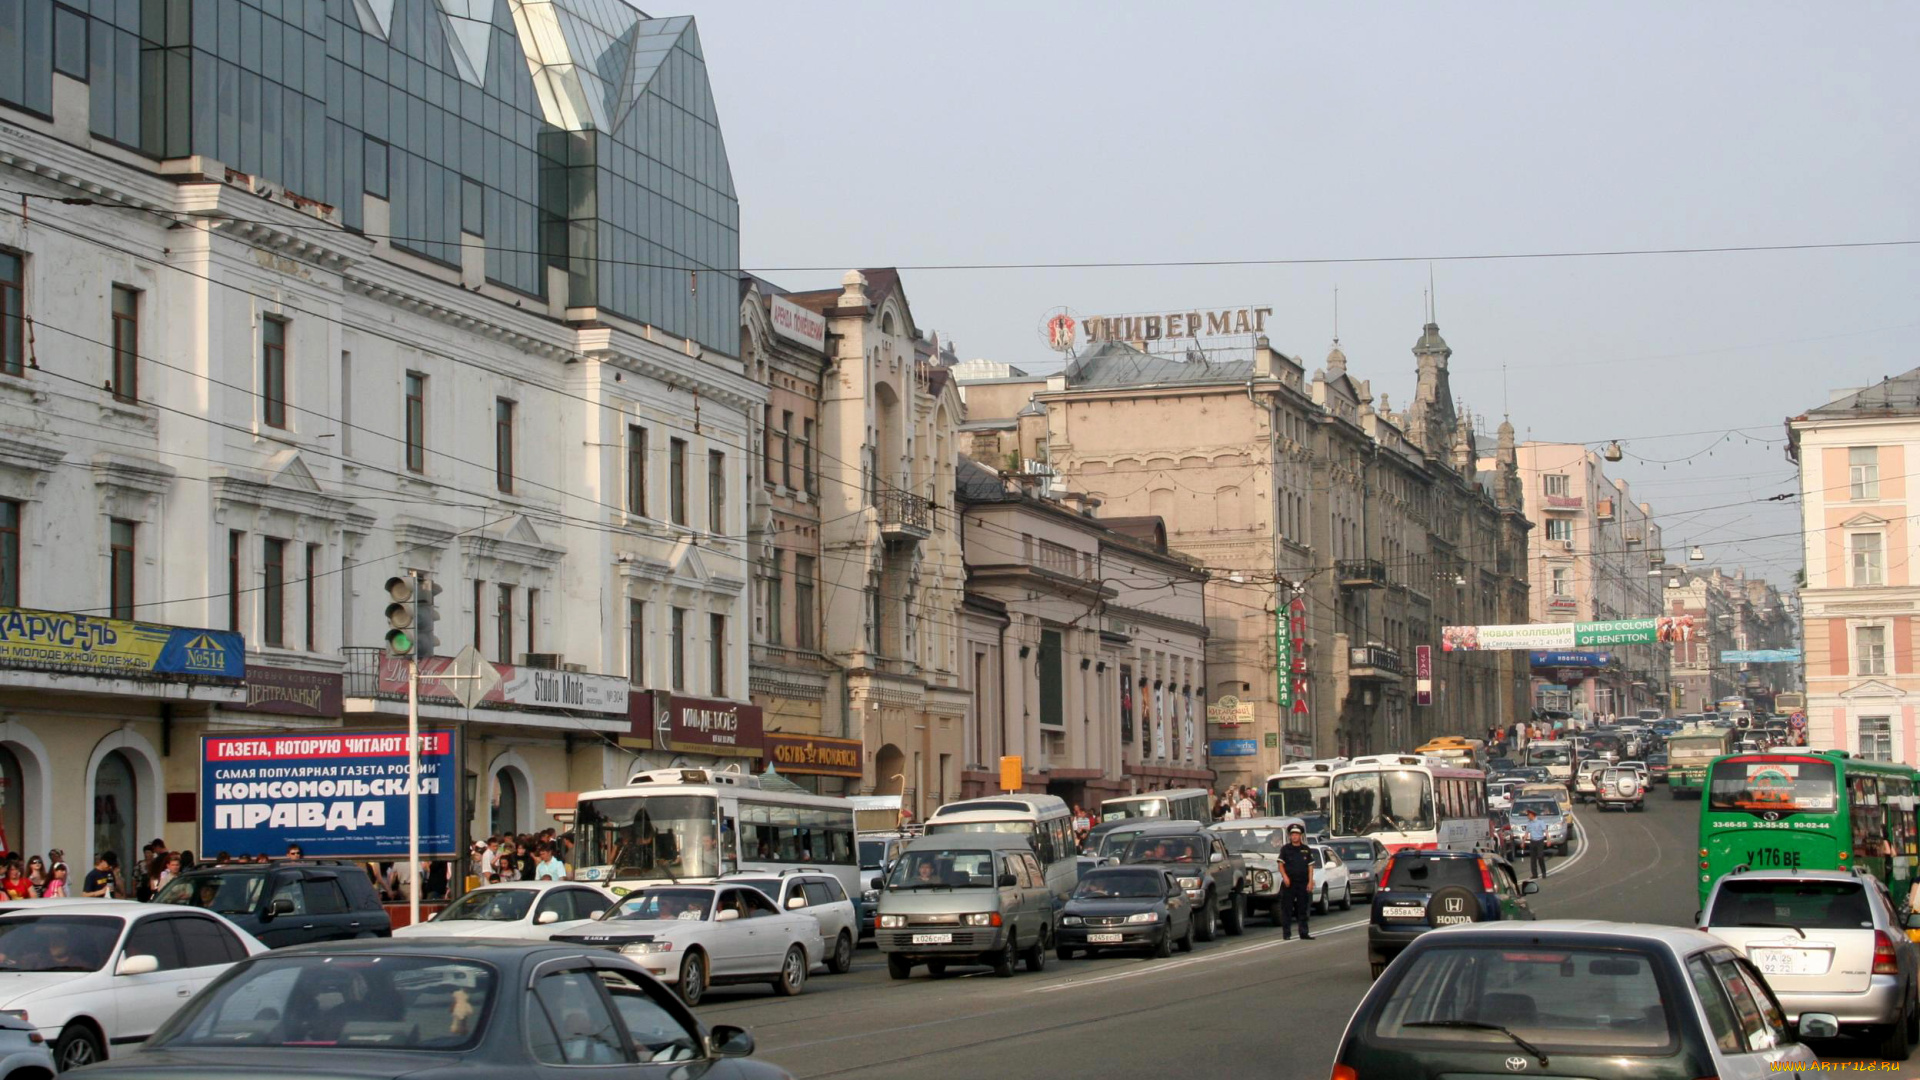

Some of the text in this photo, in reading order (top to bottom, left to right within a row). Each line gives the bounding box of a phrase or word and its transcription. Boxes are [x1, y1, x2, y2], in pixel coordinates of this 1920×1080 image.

[1081, 307, 1273, 345] УНИВЕРМАГ
[1482, 627, 1572, 639] НОВАЯ КОЛЛЕКЦИЯ
[1576, 620, 1654, 633] UNITED COLORS
[1581, 635, 1595, 645] OF
[13, 646, 98, 663] МОЛОДЕЖНОЙ
[100, 655, 151, 668] ОДЕЖДЫ
[1291, 597, 1309, 715] АПТЕКА
[245, 682, 322, 712] ЦЕНТРАЛЬНЫЙ
[535, 671, 559, 703] Studio
[562, 674, 584, 705] Moda
[218, 736, 439, 758] ГАЗЕТА, КОТОРУЮ ЧИТАЮТ ВЕ!
[775, 744, 806, 764] ОБУВЬ
[818, 747, 857, 767] MONARCH
[215, 768, 257, 780] САМАЯ
[259, 766, 337, 779] ПОПУЛЯРНАЯ
[340, 764, 385, 776] ГАЗЕТА
[215, 777, 440, 800] КОМСОМОЛЬСКАЯ
[215, 800, 386, 831] ПРАВДА
[1794, 822, 1830, 830] 90-02-44
[1757, 848, 1780, 866] 176
[1783, 851, 1801, 867] ВЕ
[1436, 915, 1473, 925] HONDA
